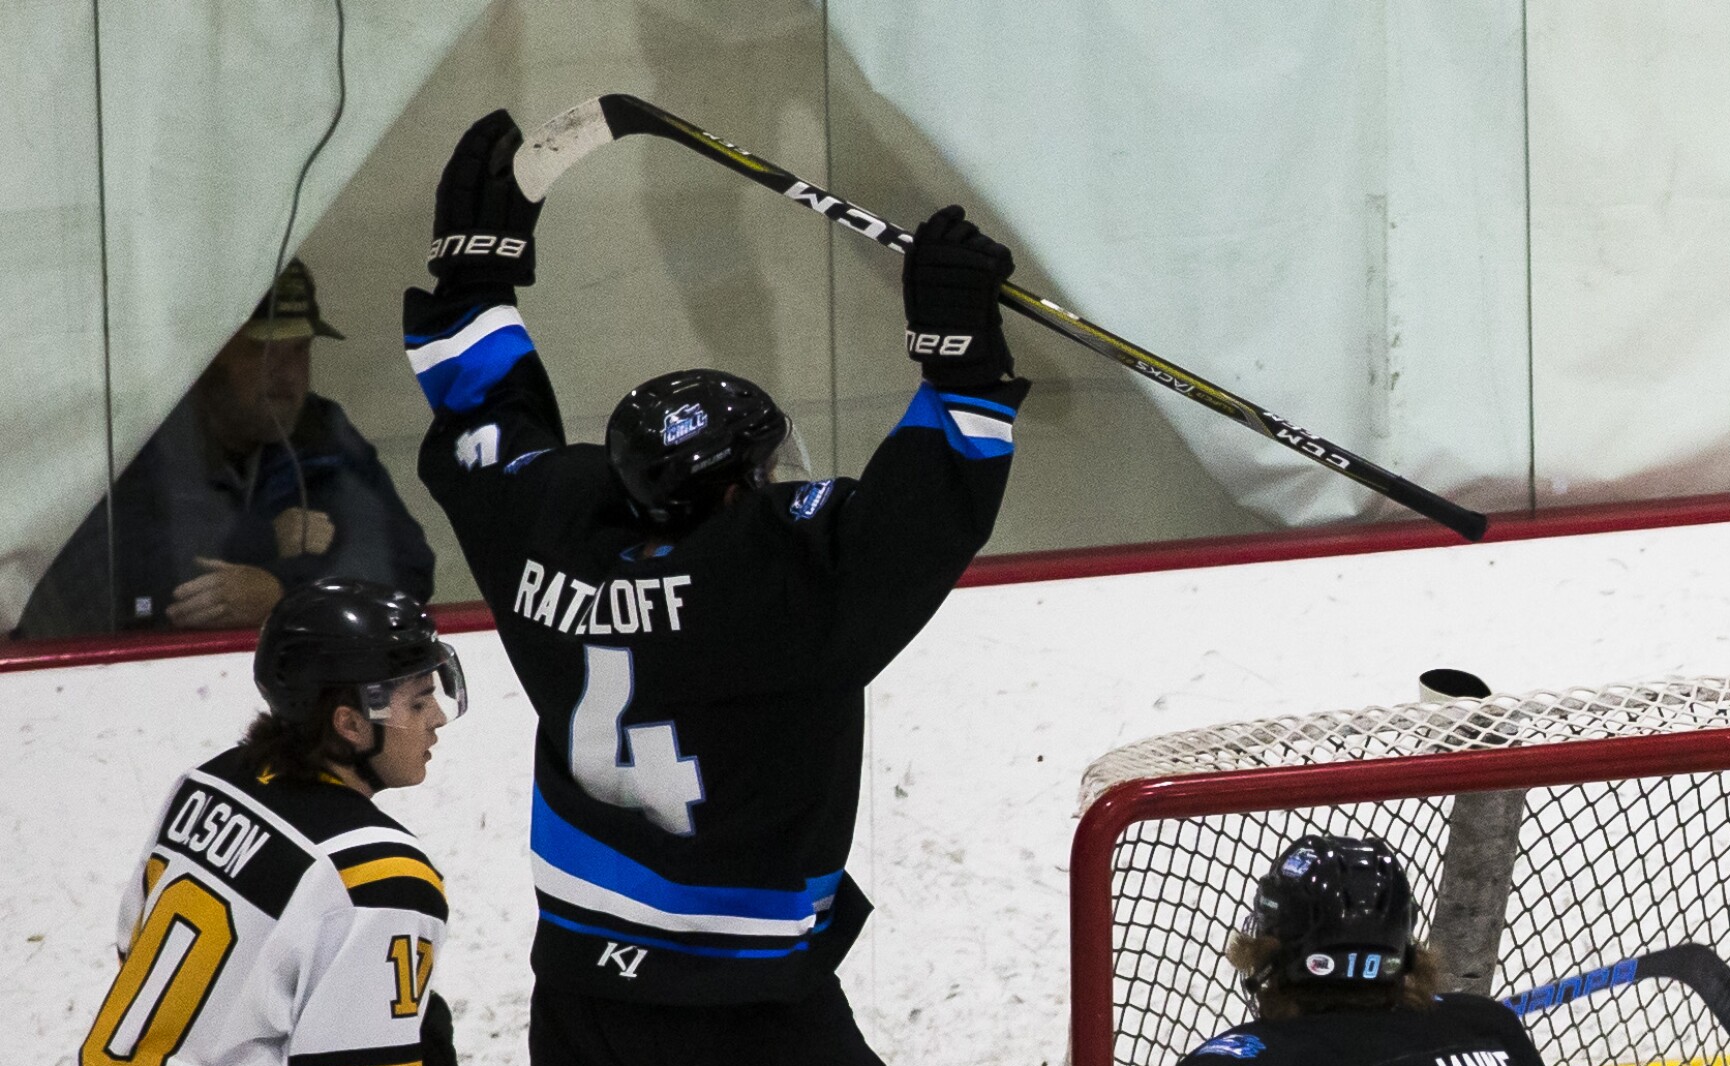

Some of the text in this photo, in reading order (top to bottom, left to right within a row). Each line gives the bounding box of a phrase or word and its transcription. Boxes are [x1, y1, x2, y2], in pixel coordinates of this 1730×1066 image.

[1276, 428, 1350, 469] CCM
[514, 559, 691, 635] RATLOFF
[569, 644, 706, 837] 4
[1347, 953, 1381, 979] 10
